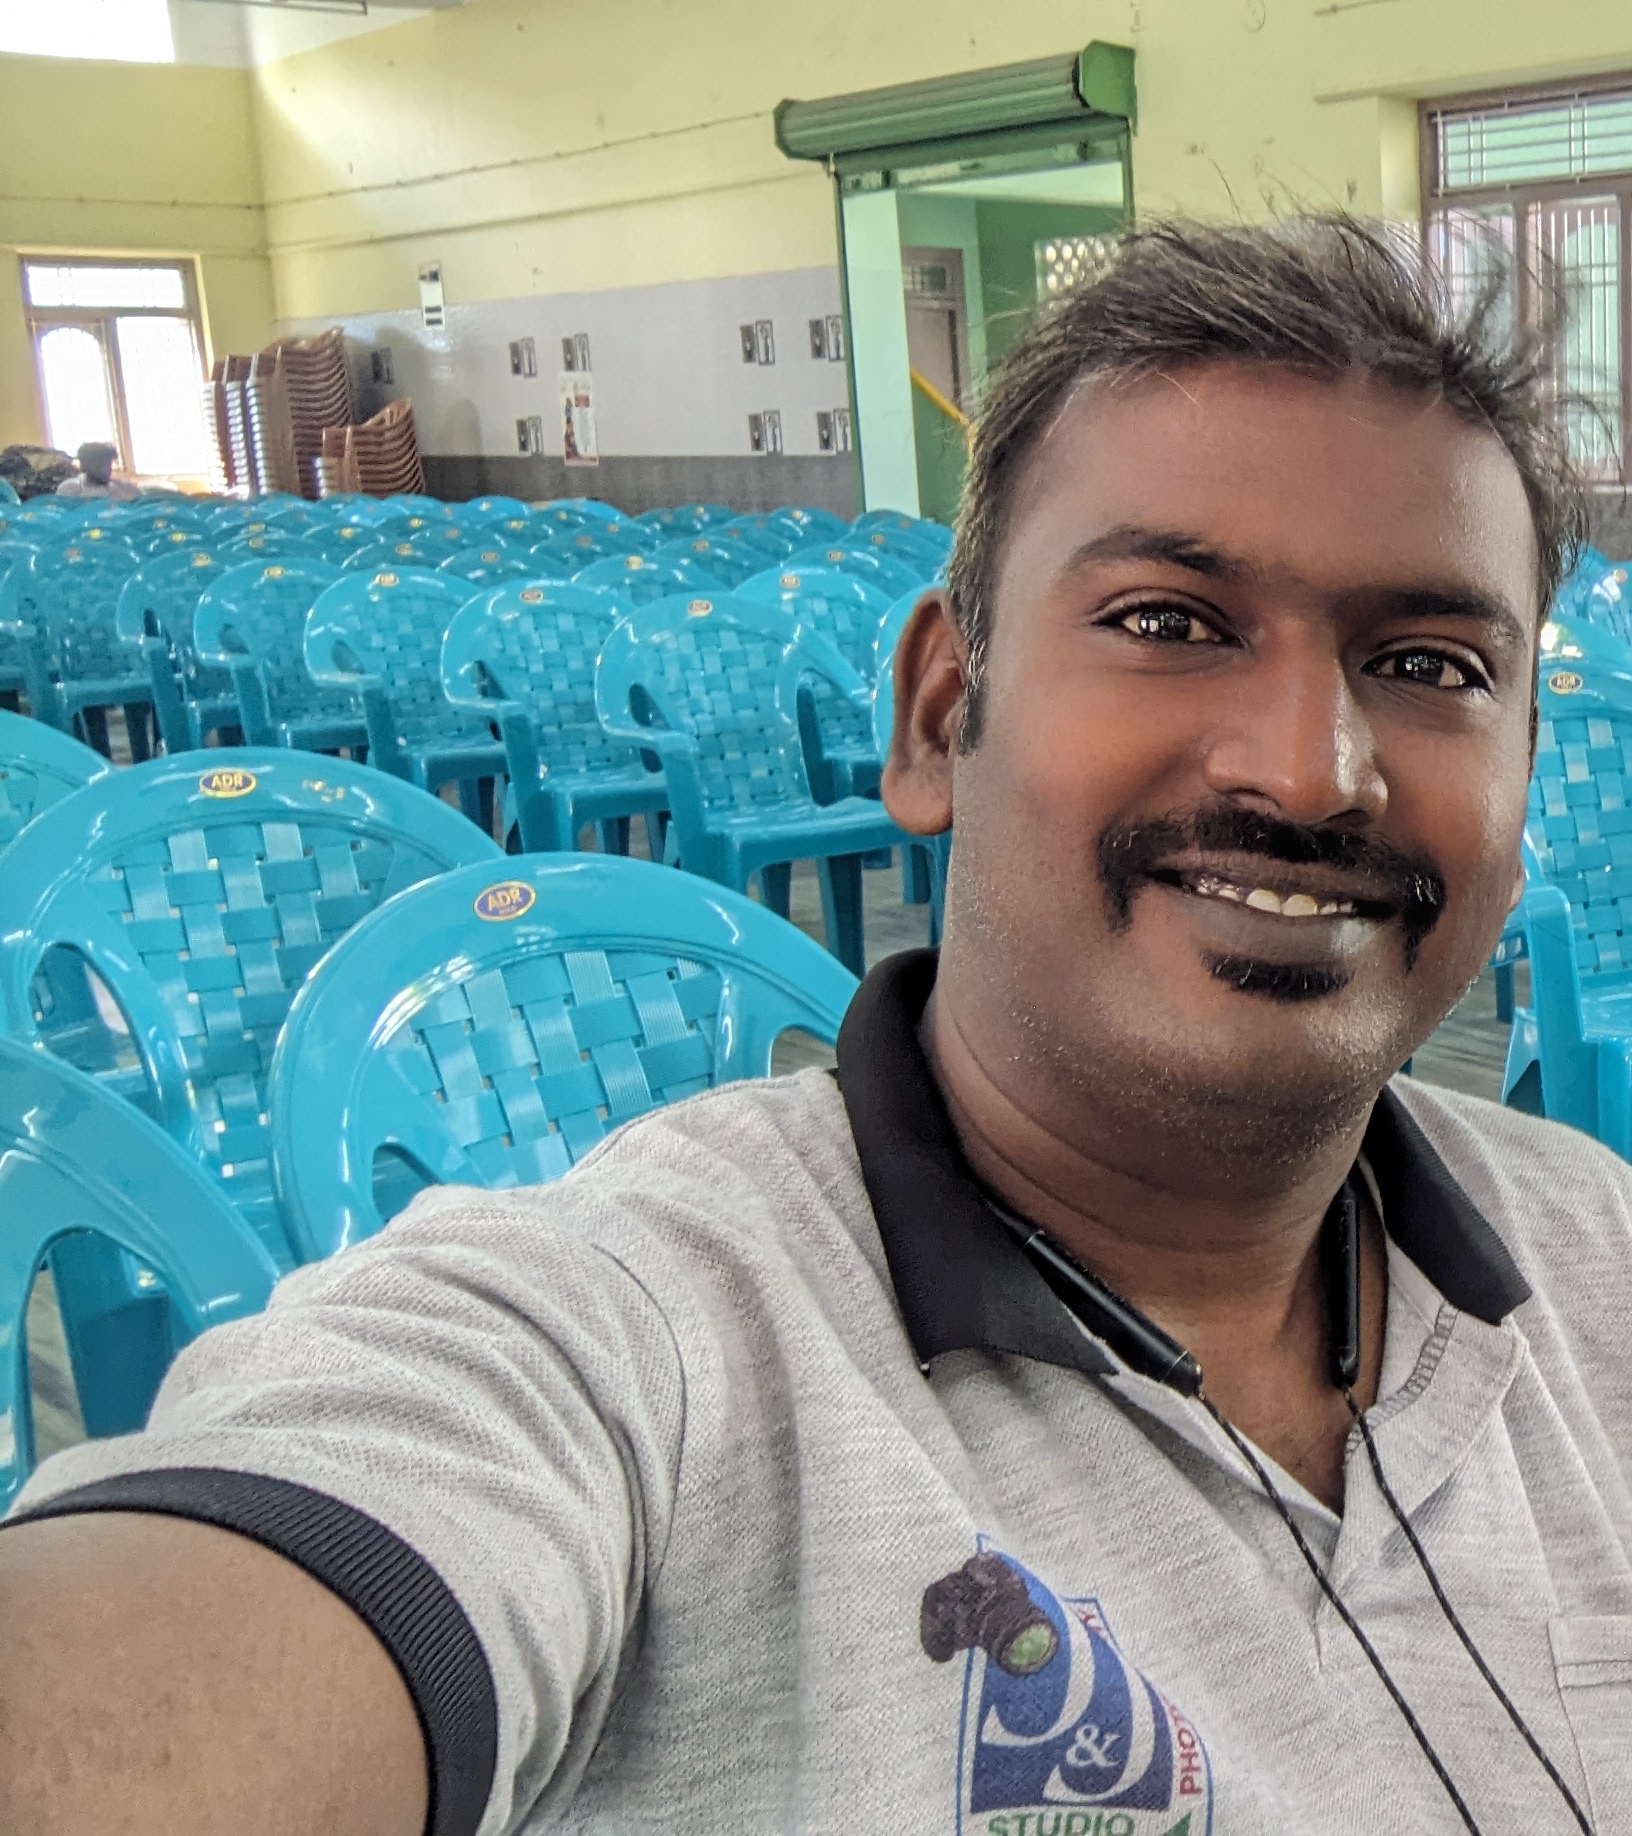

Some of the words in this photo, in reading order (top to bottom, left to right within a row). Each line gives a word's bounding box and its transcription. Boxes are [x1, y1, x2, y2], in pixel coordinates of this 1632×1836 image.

[488, 887, 523, 912] ADR
[1066, 1724, 1121, 1768] &
[987, 1812, 1135, 1836] STUDIO
